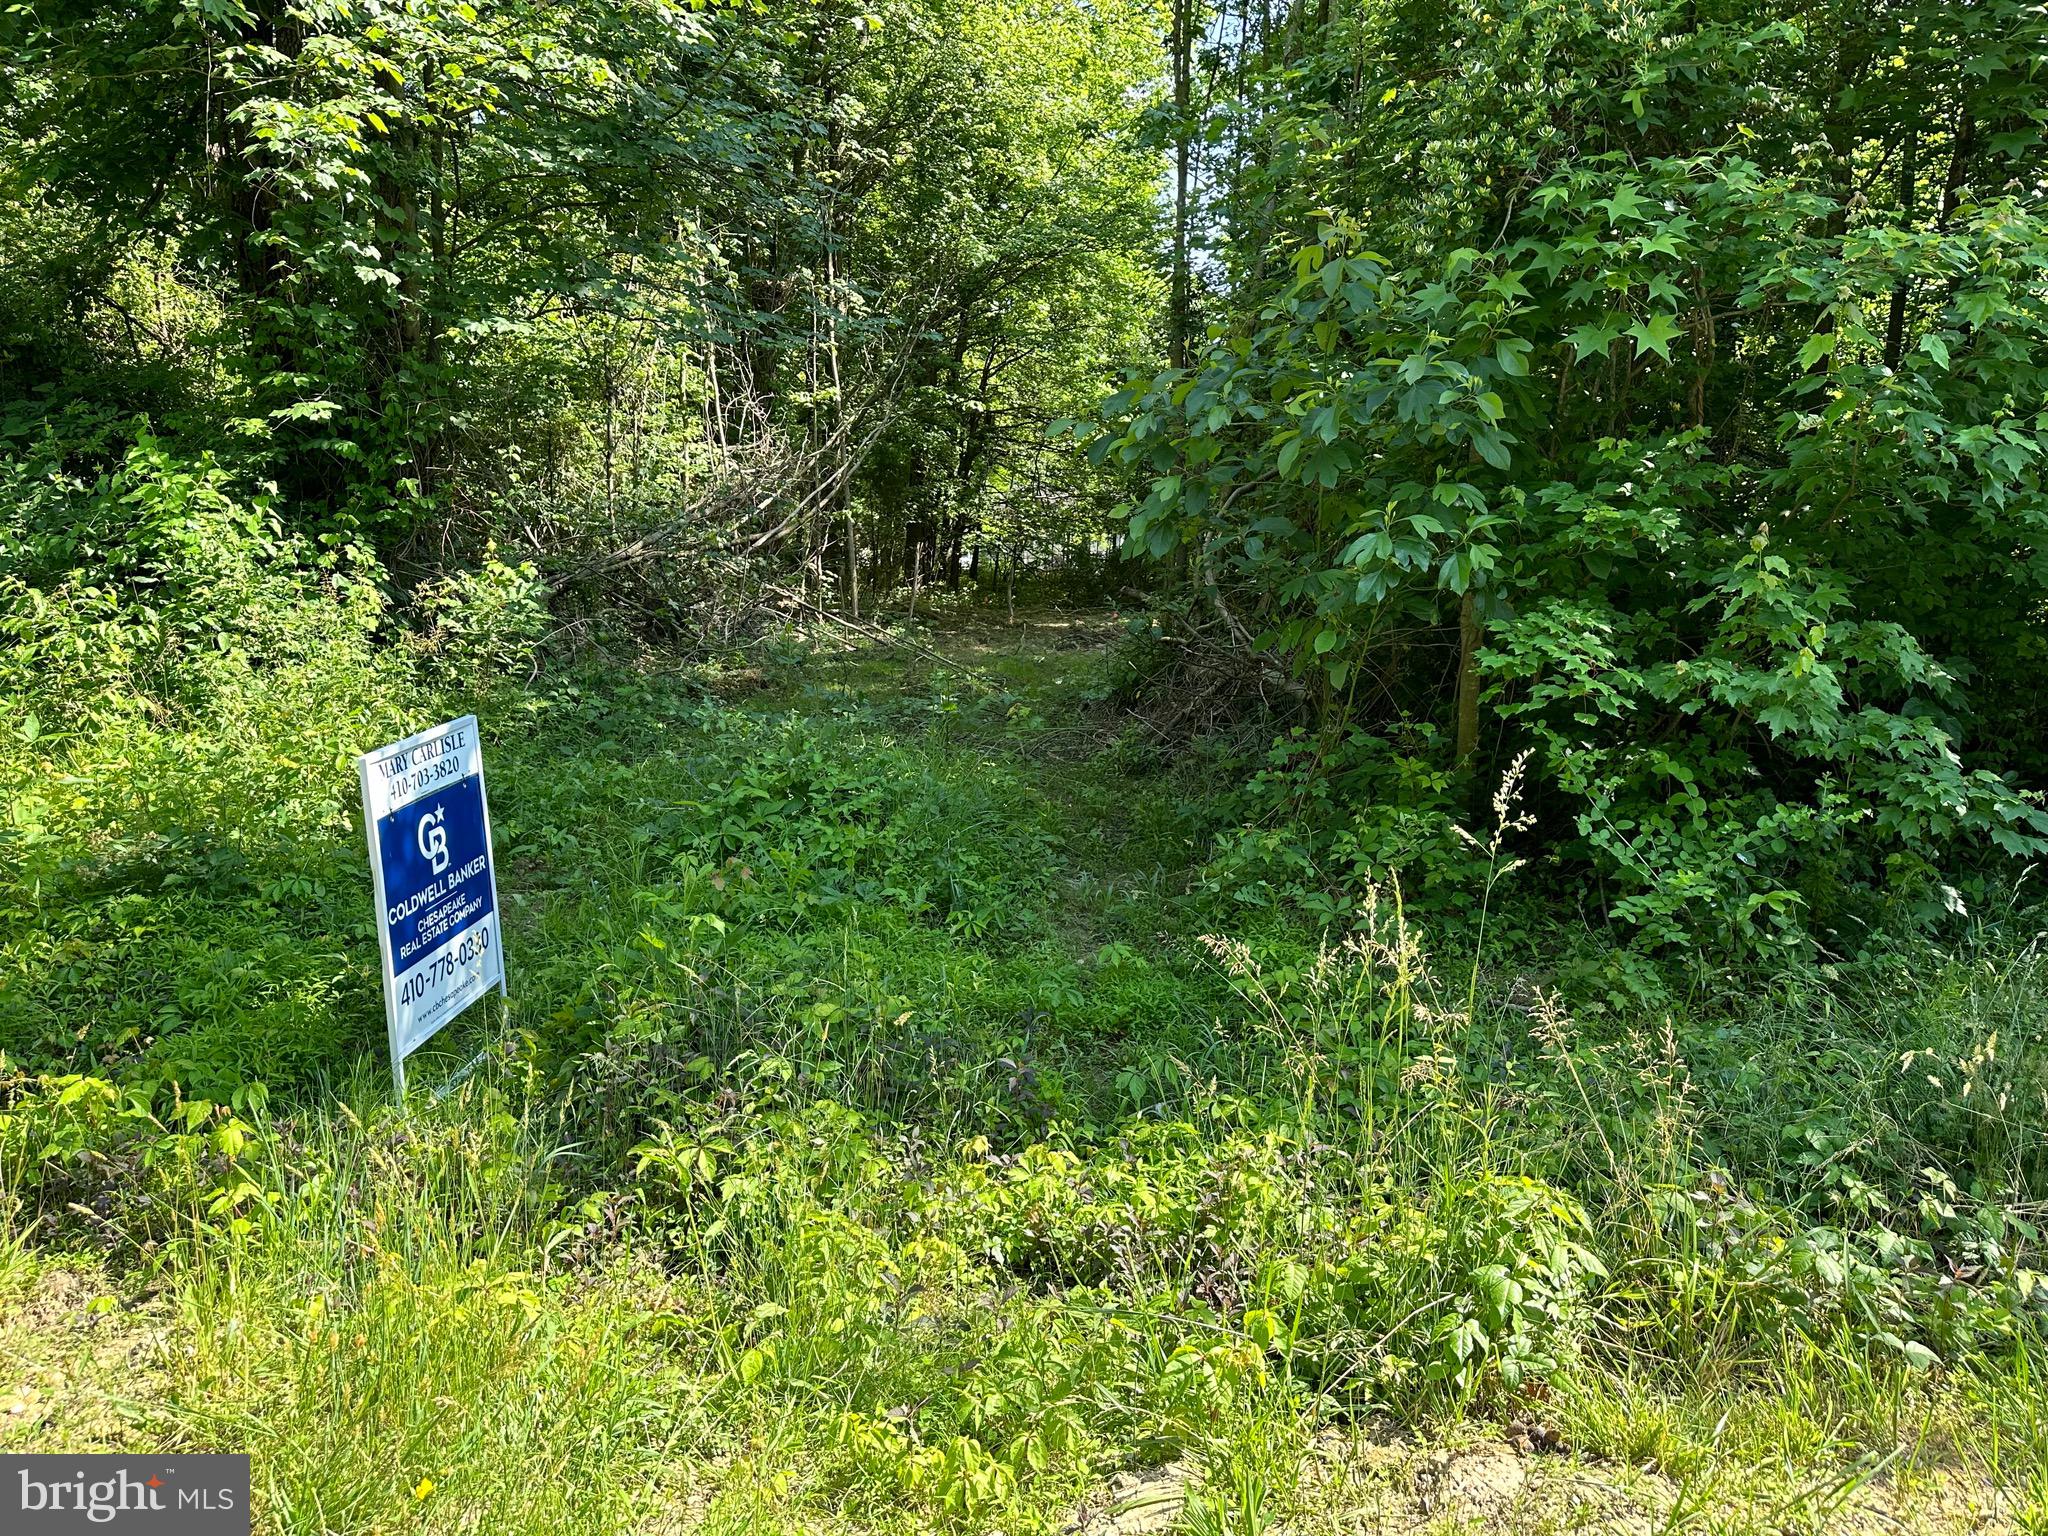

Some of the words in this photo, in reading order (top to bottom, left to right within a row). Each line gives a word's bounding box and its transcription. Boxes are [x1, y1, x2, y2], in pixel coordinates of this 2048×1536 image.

[378, 752, 409, 779] MARY
[411, 731, 466, 766] CARLISLE
[390, 755, 460, 800] 410-703-3820
[388, 879, 447, 925] COLDWELL
[448, 855, 486, 890] BANKER
[417, 893, 466, 933] CHESAPEAKE
[400, 937, 422, 960] REAL
[422, 919, 449, 944] ESTATE
[449, 896, 483, 927] COMPANY
[417, 971, 480, 1023] www.cbchesapeake.co
